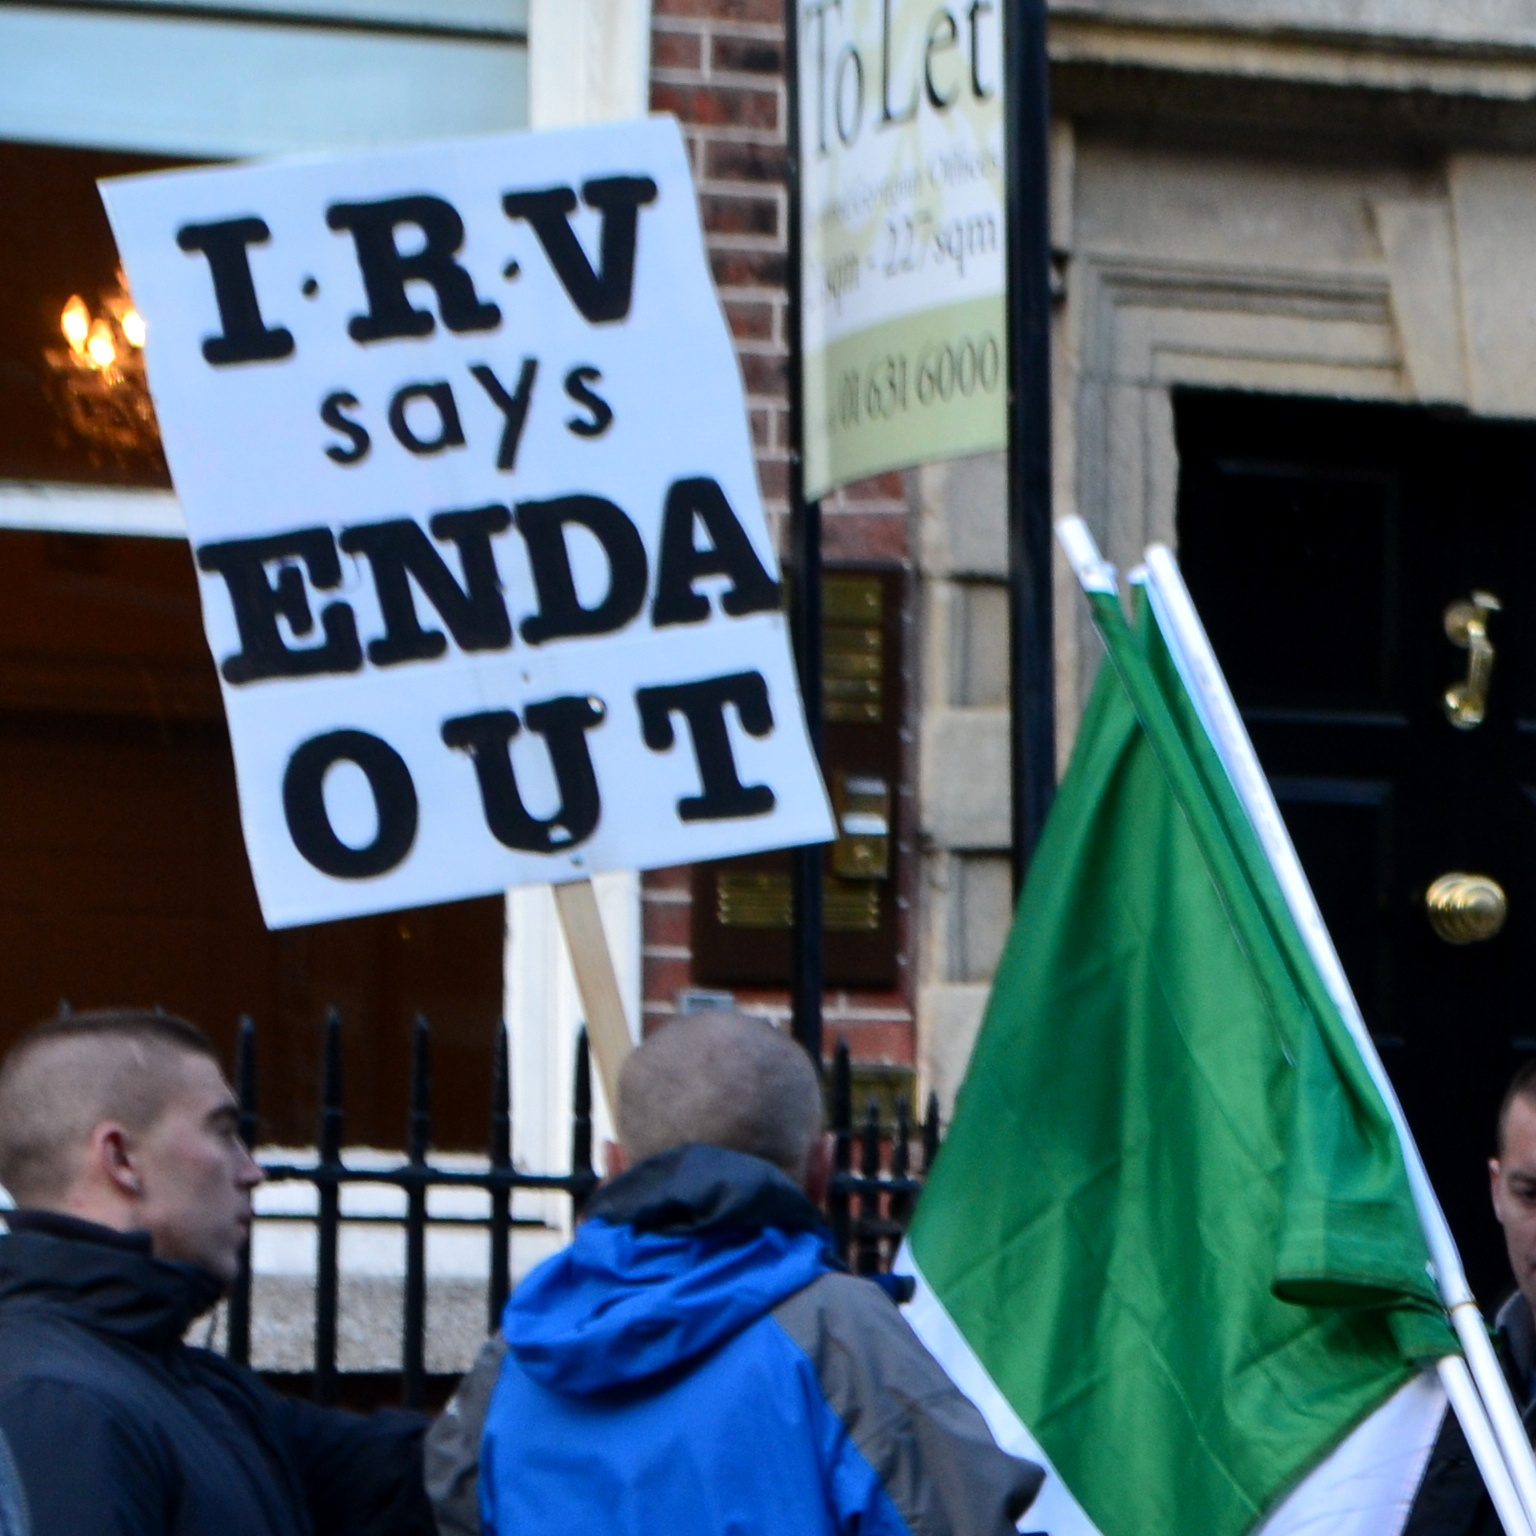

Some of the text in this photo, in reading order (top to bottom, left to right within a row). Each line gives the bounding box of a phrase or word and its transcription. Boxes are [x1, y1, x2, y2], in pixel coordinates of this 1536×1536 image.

[804, 0, 995, 159] To Let
[319, 356, 615, 471] says
[915, 330, 999, 407] 6000
[197, 475, 783, 686] ENDA
[281, 669, 778, 880] OUT
